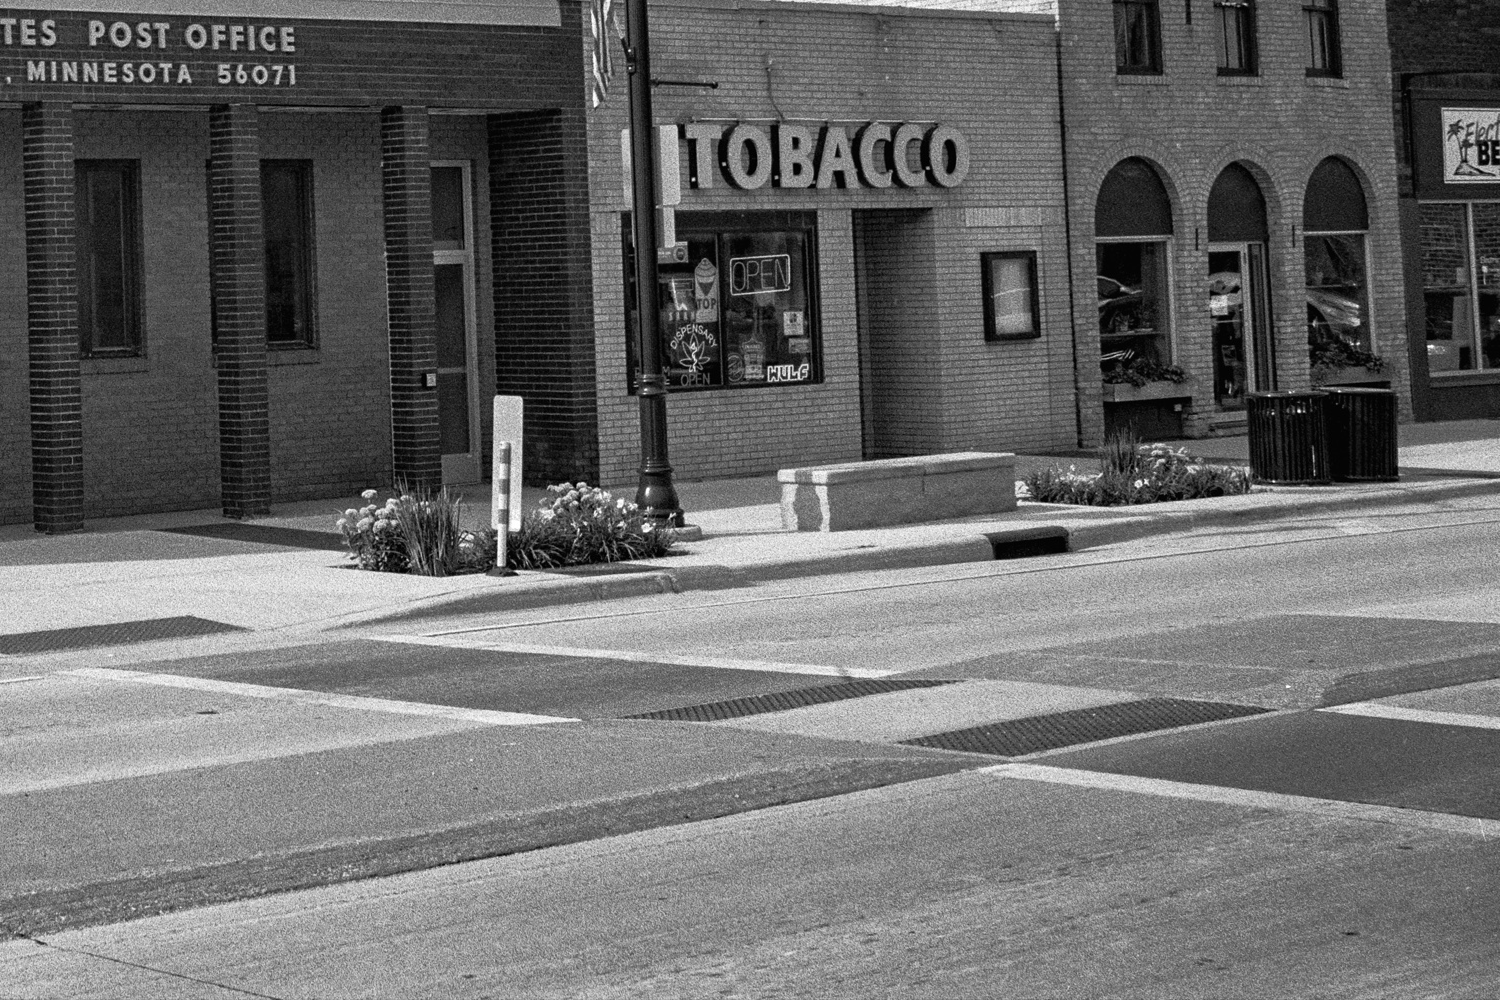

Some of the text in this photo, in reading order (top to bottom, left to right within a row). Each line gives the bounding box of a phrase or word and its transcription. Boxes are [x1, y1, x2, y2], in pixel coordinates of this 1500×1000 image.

[88, 19, 170, 49] POST
[185, 23, 296, 54] OFFICE
[27, 60, 192, 85] MINNESOTA
[218, 63, 296, 86] 56071
[685, 122, 970, 190] TOBACCO
[1477, 140, 1500, 166] BE
[733, 258, 788, 291] OPEN
[697, 297, 717, 310] TOP
[670, 323, 718, 350] DISPENSARY
[681, 372, 710, 387] OPEN
[767, 363, 809, 382] WULF
